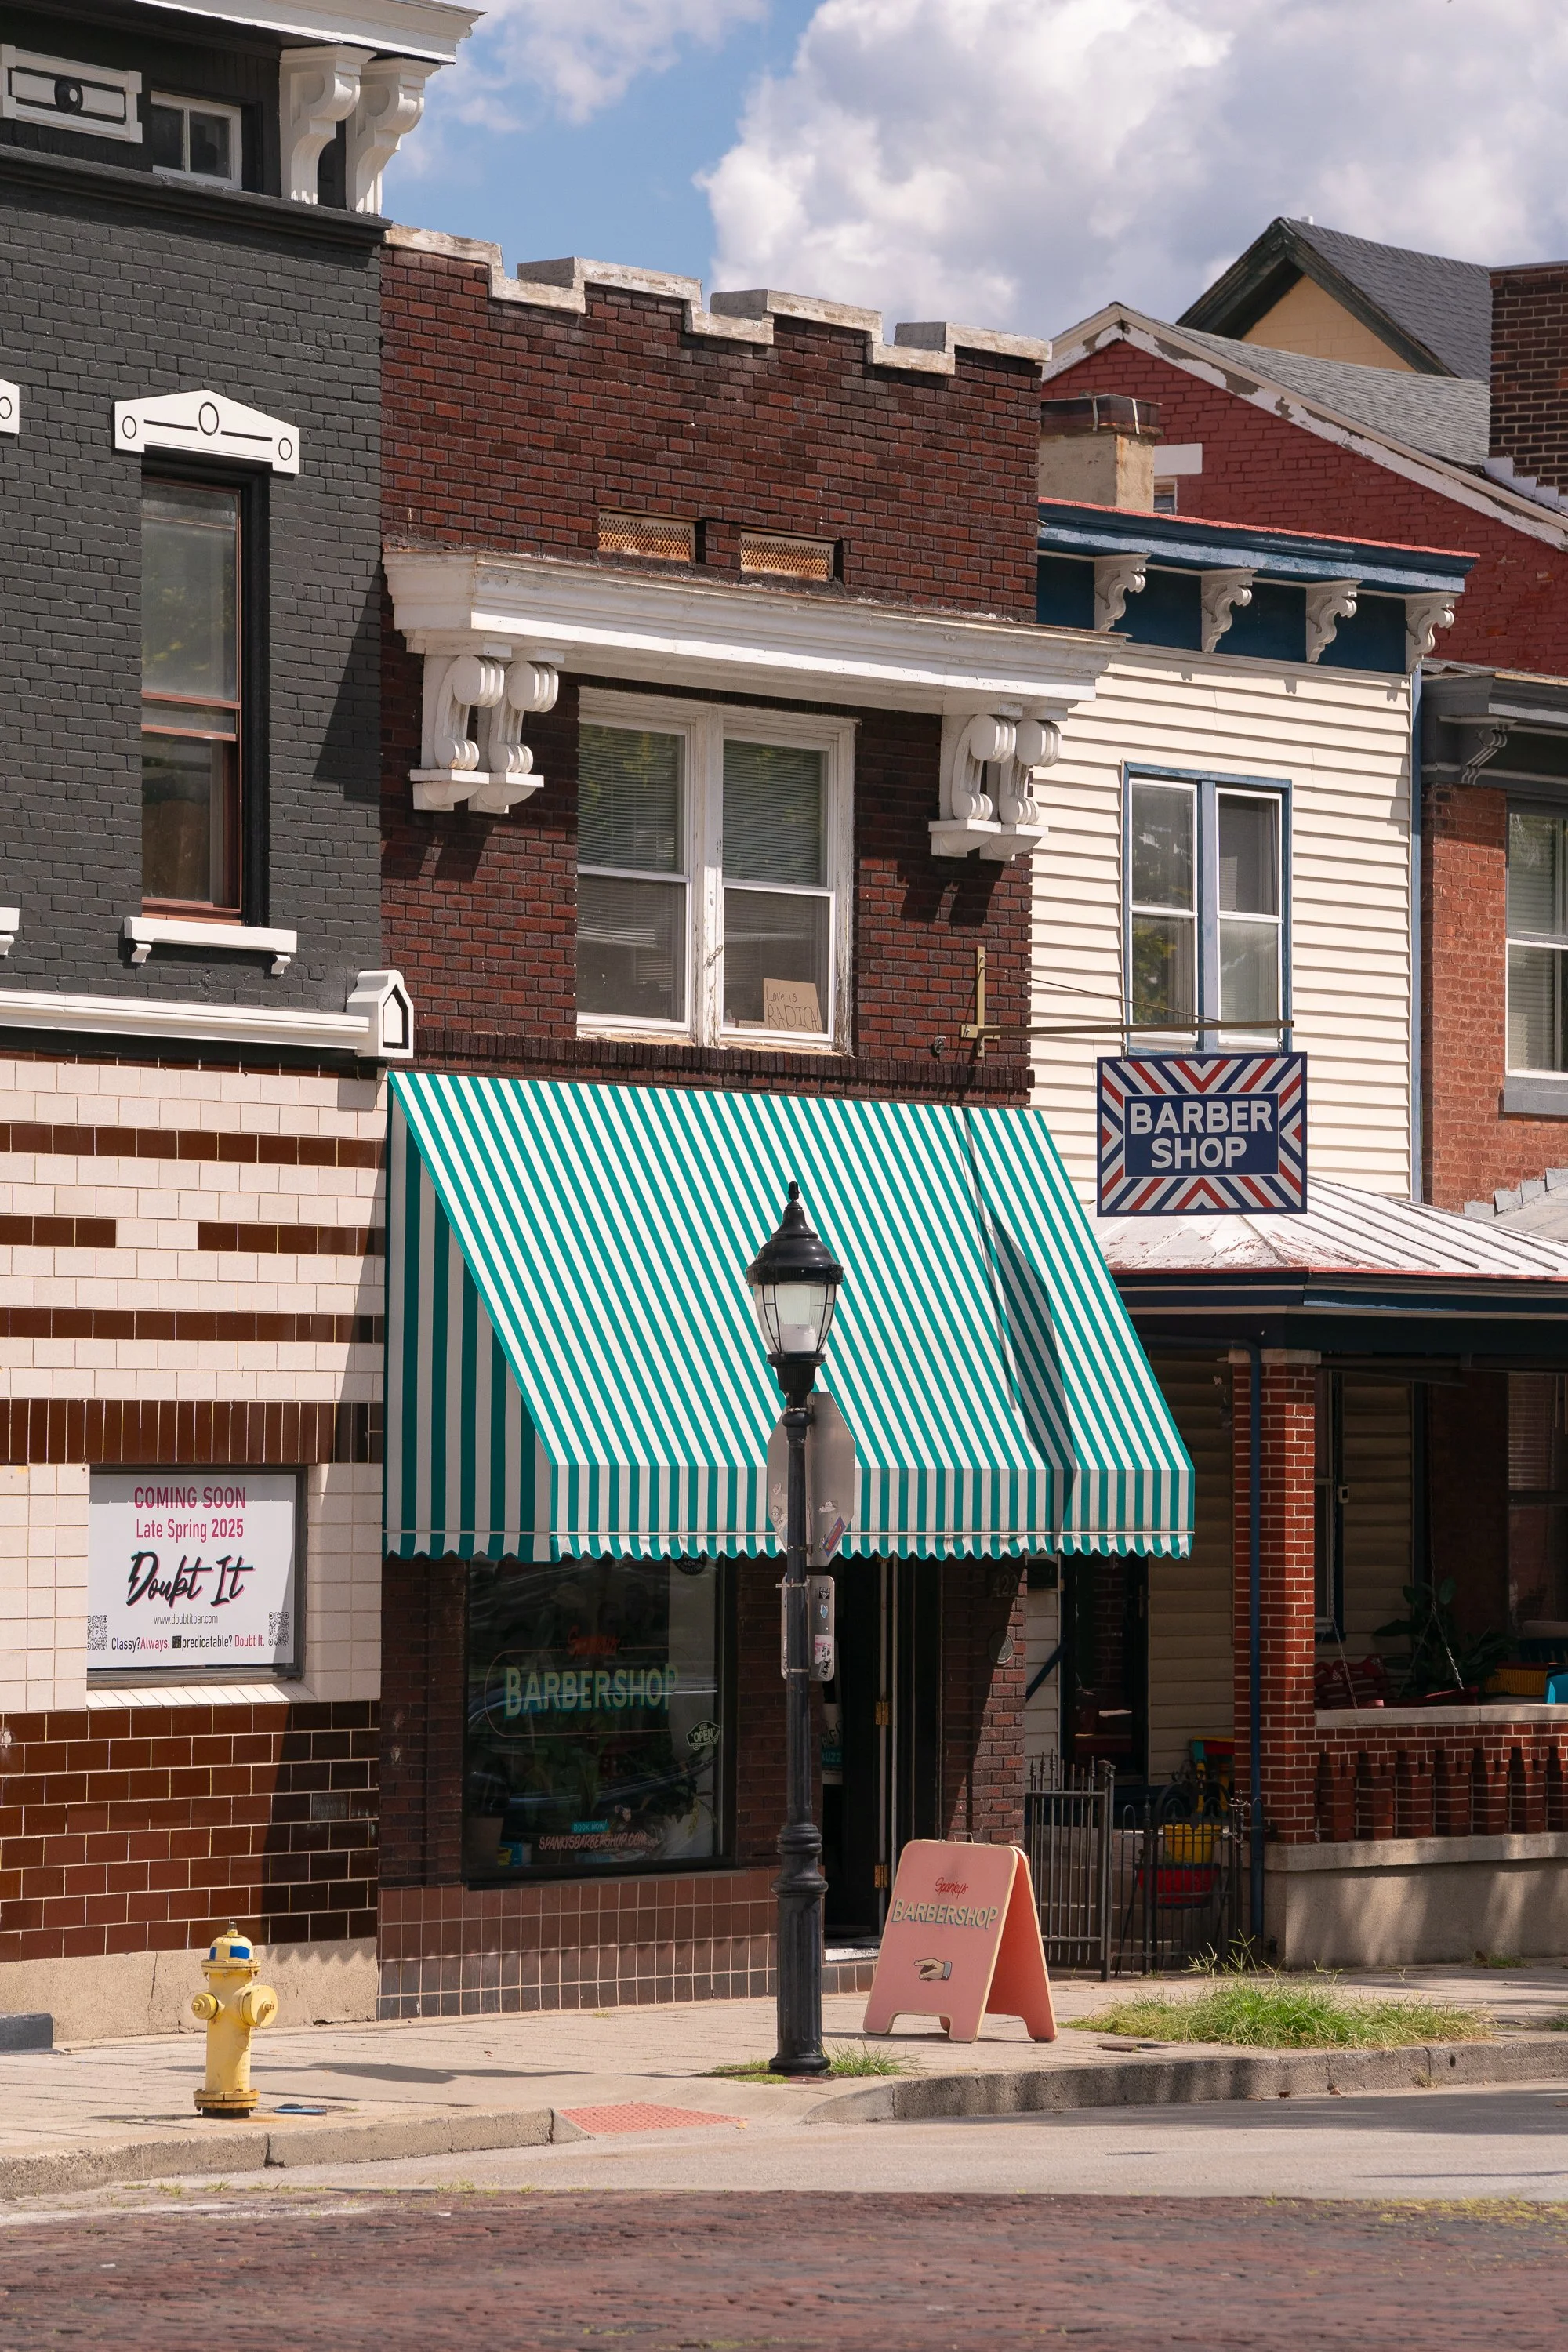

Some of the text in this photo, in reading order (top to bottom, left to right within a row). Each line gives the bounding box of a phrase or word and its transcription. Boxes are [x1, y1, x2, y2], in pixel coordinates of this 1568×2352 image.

[766, 985, 797, 1003] Love is
[768, 1004, 823, 1032] RADICAL
[1131, 1100, 1274, 1134] BARBER
[1152, 1136, 1247, 1169] SHOP
[134, 1486, 246, 1509] COMING SOON
[136, 1518, 244, 1543] Late Spring 2025
[125, 1550, 256, 1609] Doubt It
[154, 1613, 219, 1625] www.doubtitbar.com
[172, 1635, 233, 1652] predicatable?
[234, 1635, 256, 1647] Doubt
[504, 1663, 680, 1719] BARBERSHOP
[891, 1898, 998, 1930] BARBERSHOP
